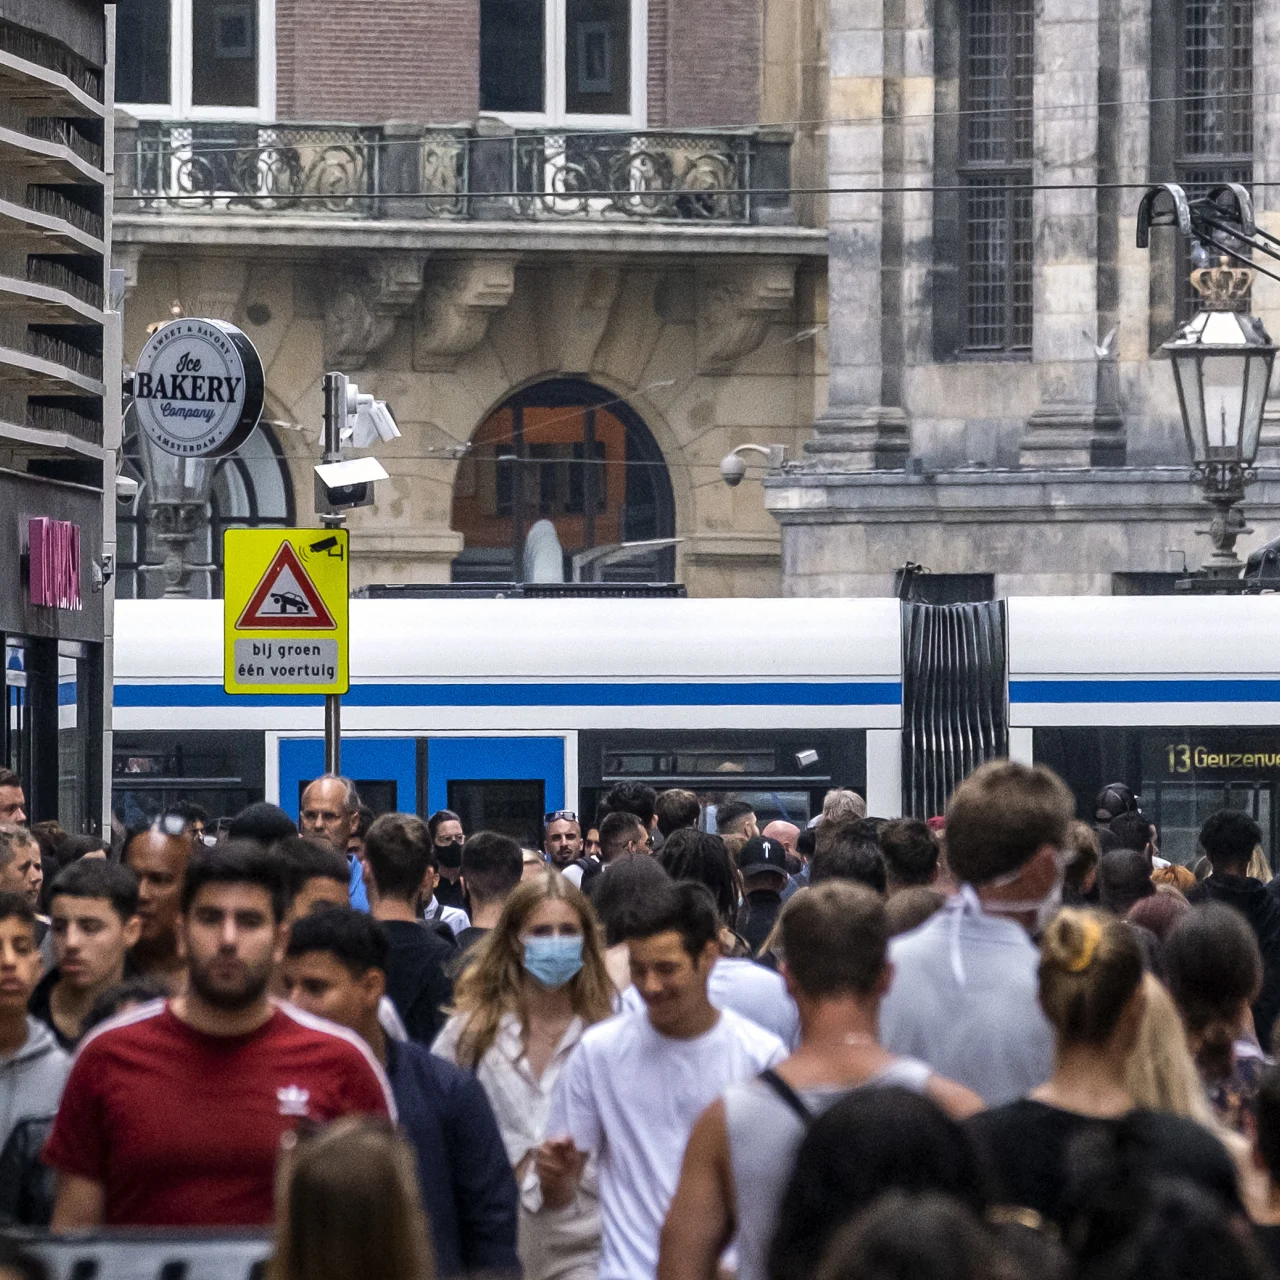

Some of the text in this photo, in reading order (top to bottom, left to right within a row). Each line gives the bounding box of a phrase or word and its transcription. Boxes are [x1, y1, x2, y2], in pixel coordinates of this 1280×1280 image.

[152, 326, 182, 352] SWEET
[198, 326, 231, 355] SAVORY
[136, 372, 242, 403] BAKERY
[161, 402, 216, 423] Company
[156, 434, 217, 452] AMSTERDAM
[252, 643, 321, 659] bij groen
[238, 663, 335, 680] één voertuig
[1165, 743, 1191, 773] 13
